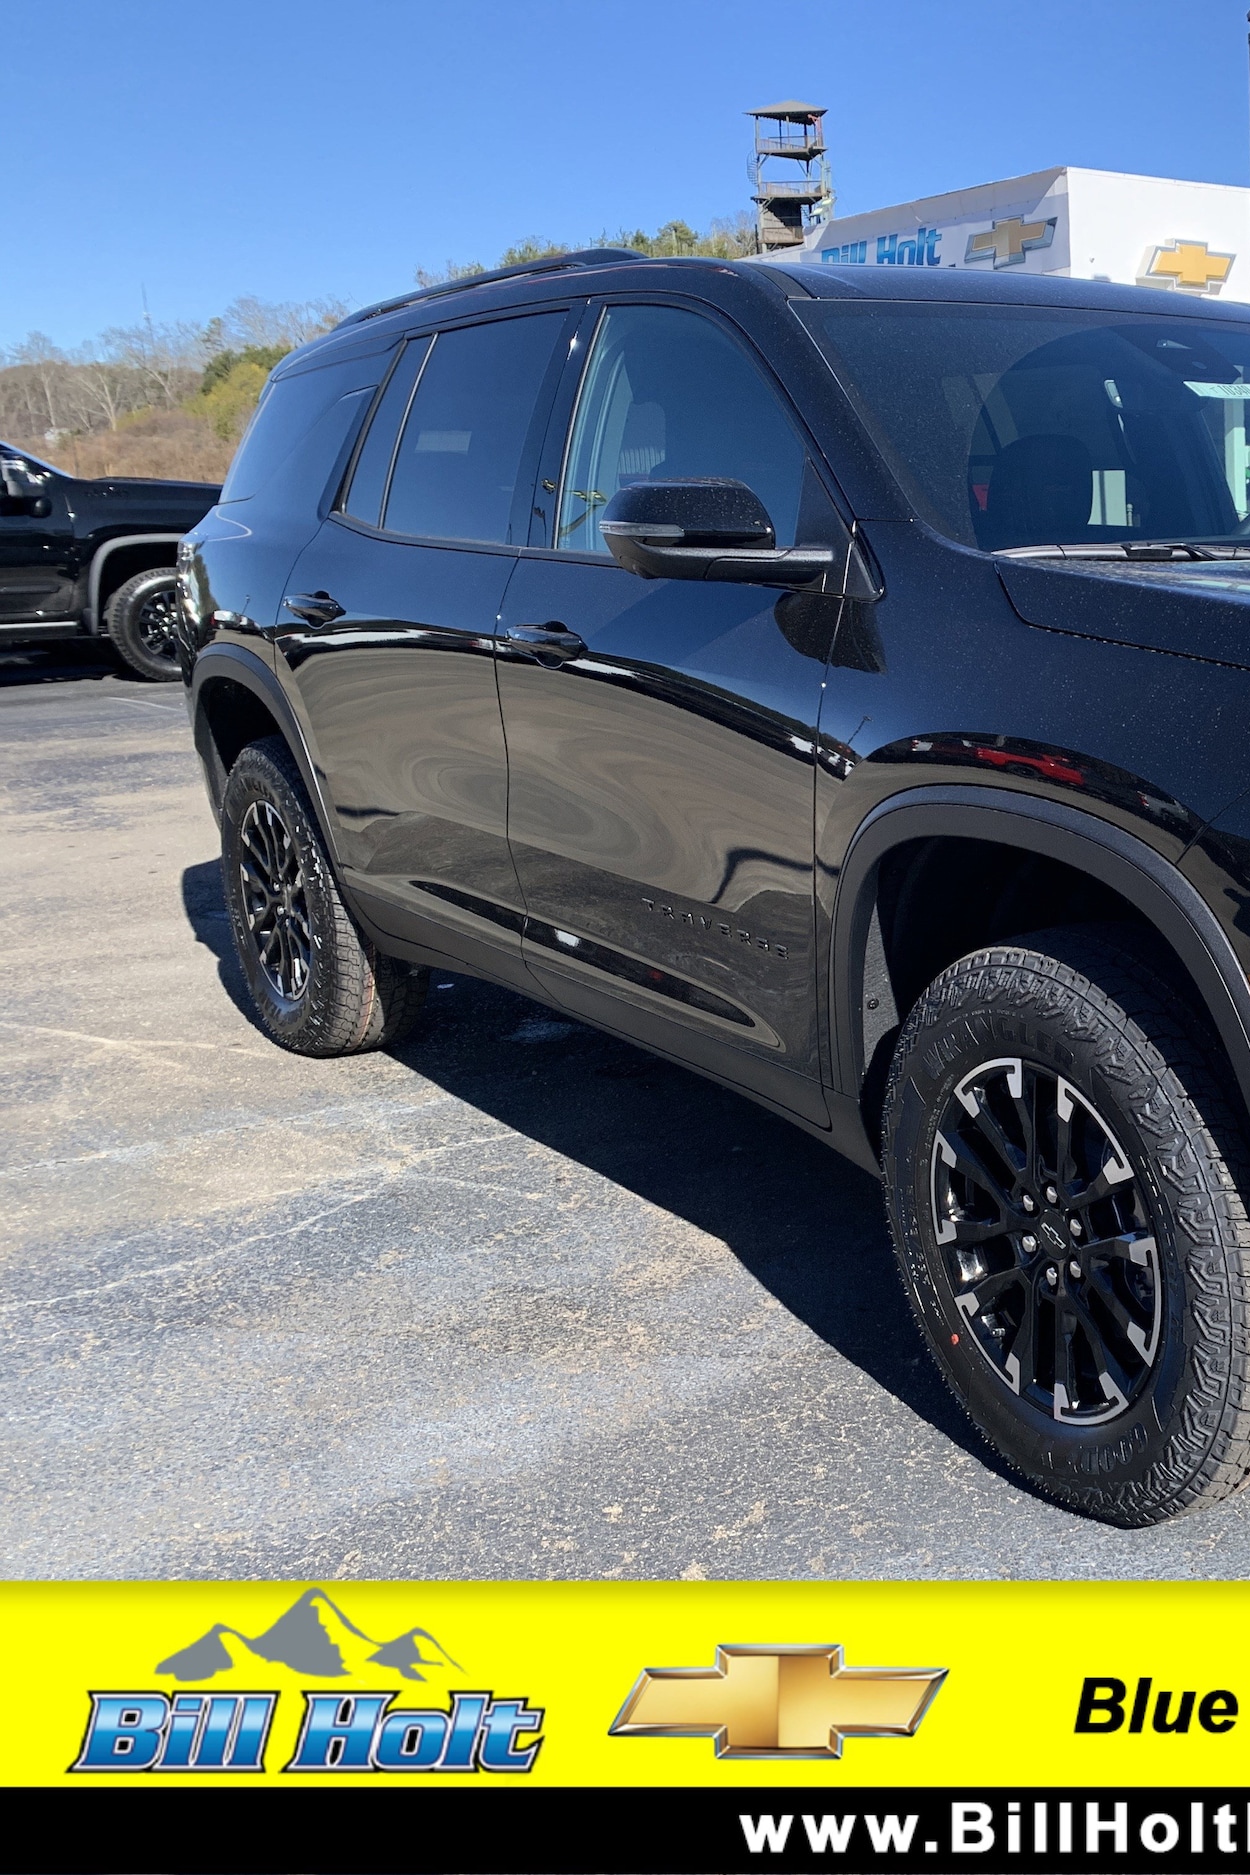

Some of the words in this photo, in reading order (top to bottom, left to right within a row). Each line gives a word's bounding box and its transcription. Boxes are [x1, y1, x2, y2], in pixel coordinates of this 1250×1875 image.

[877, 227, 942, 266] Holt
[641, 897, 789, 960] TRAVERSE
[921, 1015, 1076, 1081] WRANGLER
